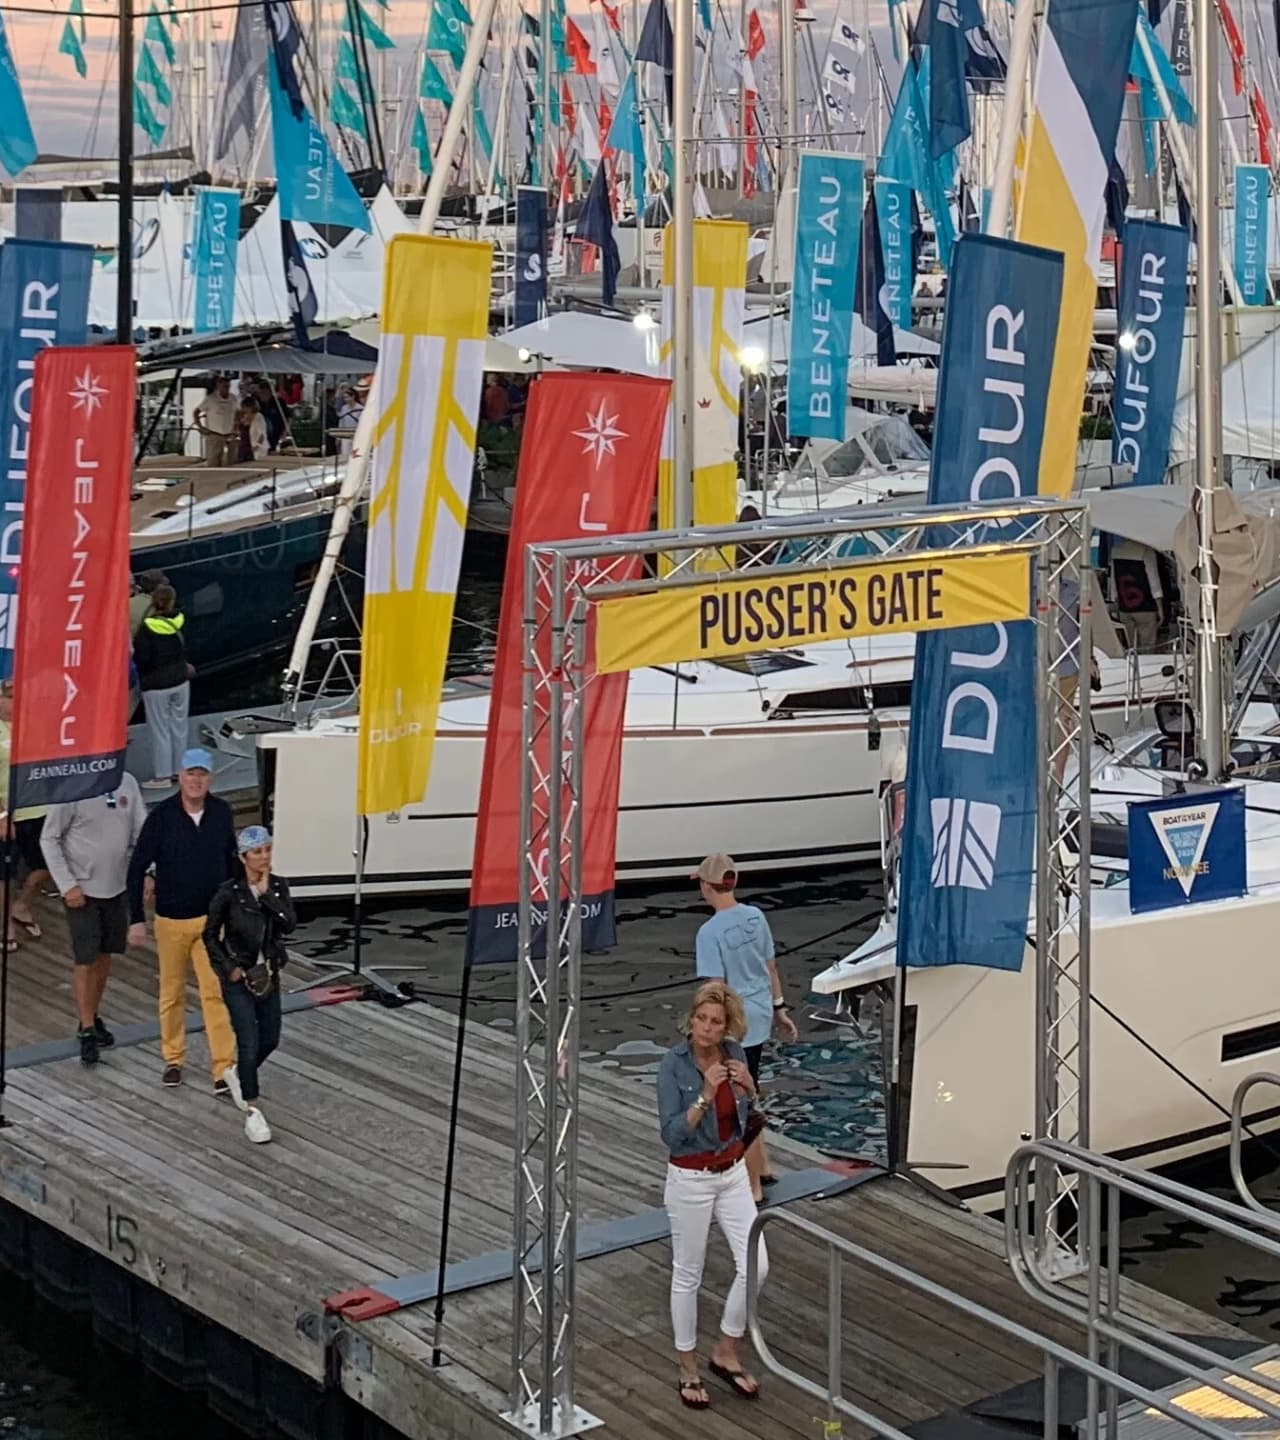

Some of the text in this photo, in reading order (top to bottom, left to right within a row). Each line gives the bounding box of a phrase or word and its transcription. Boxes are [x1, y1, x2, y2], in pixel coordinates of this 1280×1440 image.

[206, 201, 231, 329] ENETEAU
[811, 175, 842, 418] BENETEAU
[888, 194, 902, 323] ENETEAU
[1244, 175, 1258, 297] BENETEAU
[1117, 251, 1166, 474] DUFOUR
[59, 437, 100, 746] JEANNEAU
[940, 303, 1027, 756] DUOUR
[699, 568, 945, 649] PUSSER'S GATE
[106, 1204, 139, 1265] 15
